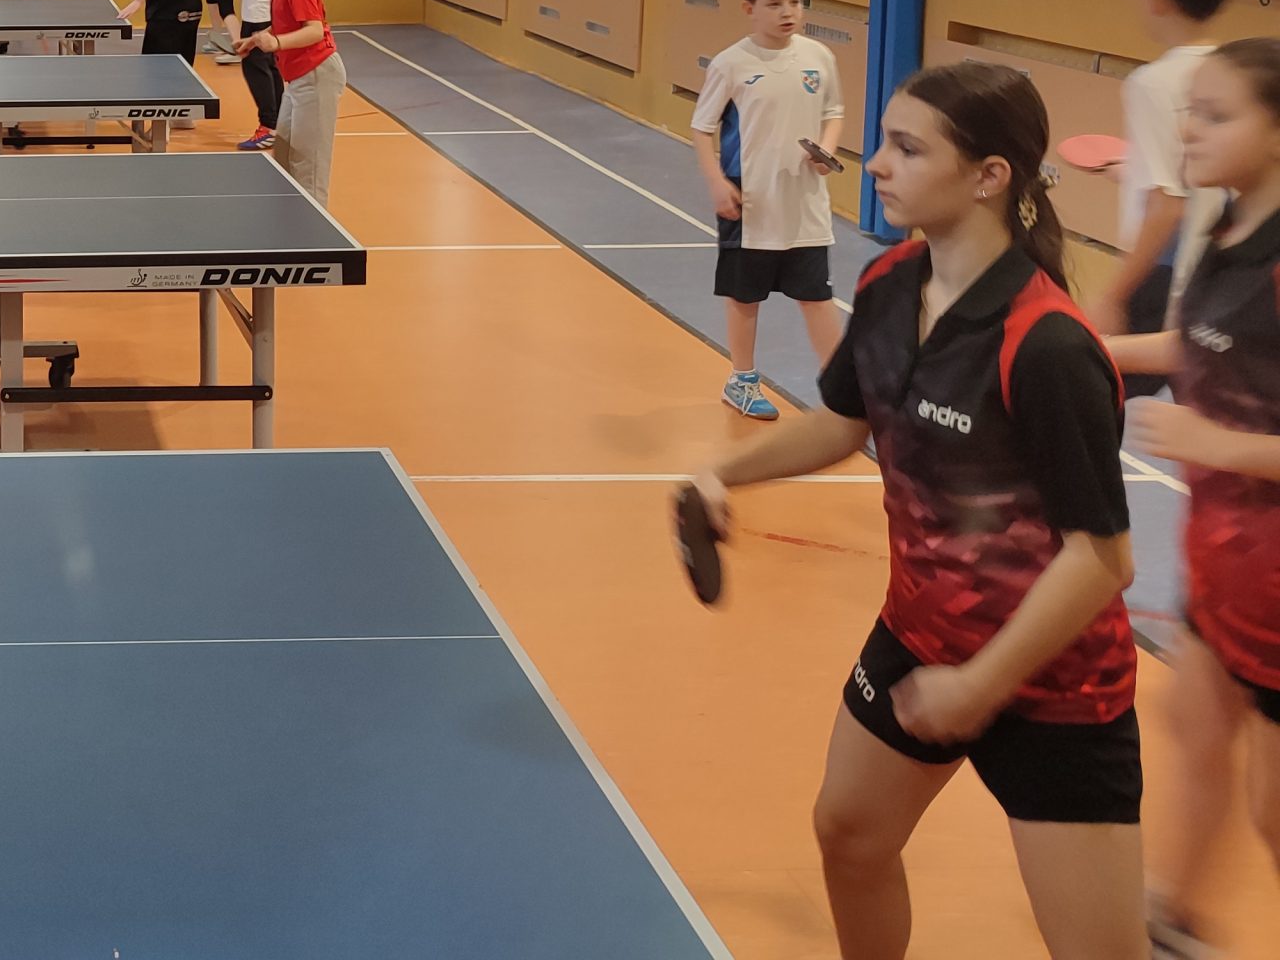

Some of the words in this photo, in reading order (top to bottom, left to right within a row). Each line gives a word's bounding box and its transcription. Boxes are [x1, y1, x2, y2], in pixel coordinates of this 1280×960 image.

[64, 31, 111, 39] DONIC
[127, 108, 191, 118] DONIC
[200, 267, 331, 285] DONIC
[917, 398, 972, 435] andro
